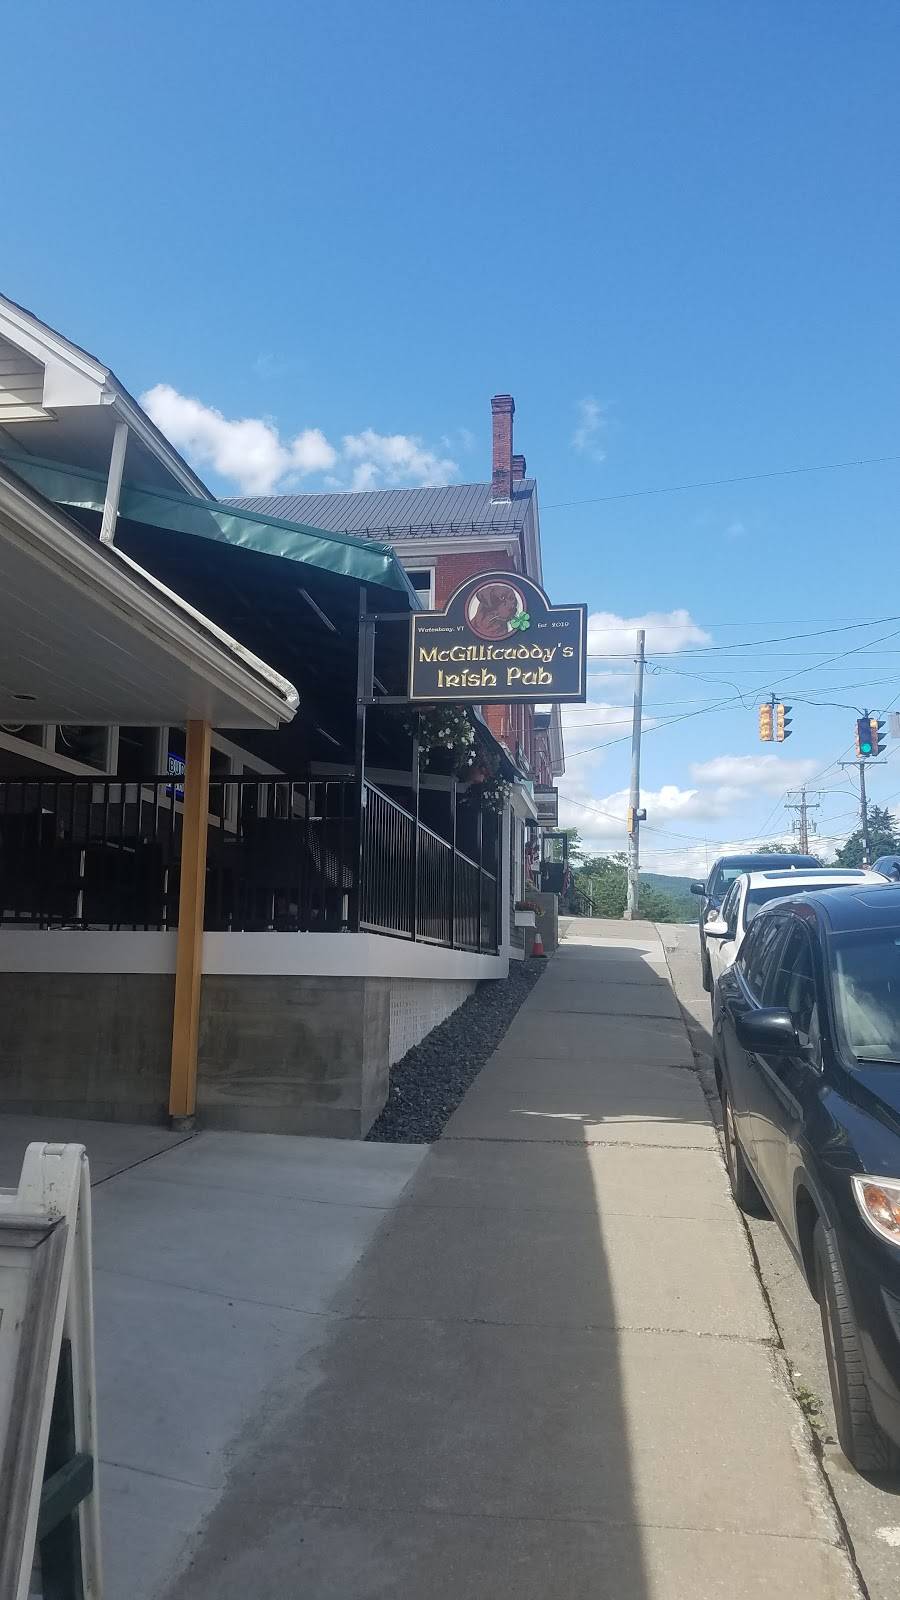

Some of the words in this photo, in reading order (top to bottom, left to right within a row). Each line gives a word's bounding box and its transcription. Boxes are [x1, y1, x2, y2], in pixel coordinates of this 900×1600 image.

[419, 642, 574, 663] McGillicuddy's
[437, 667, 497, 688] Irish
[506, 666, 553, 686] Pub
